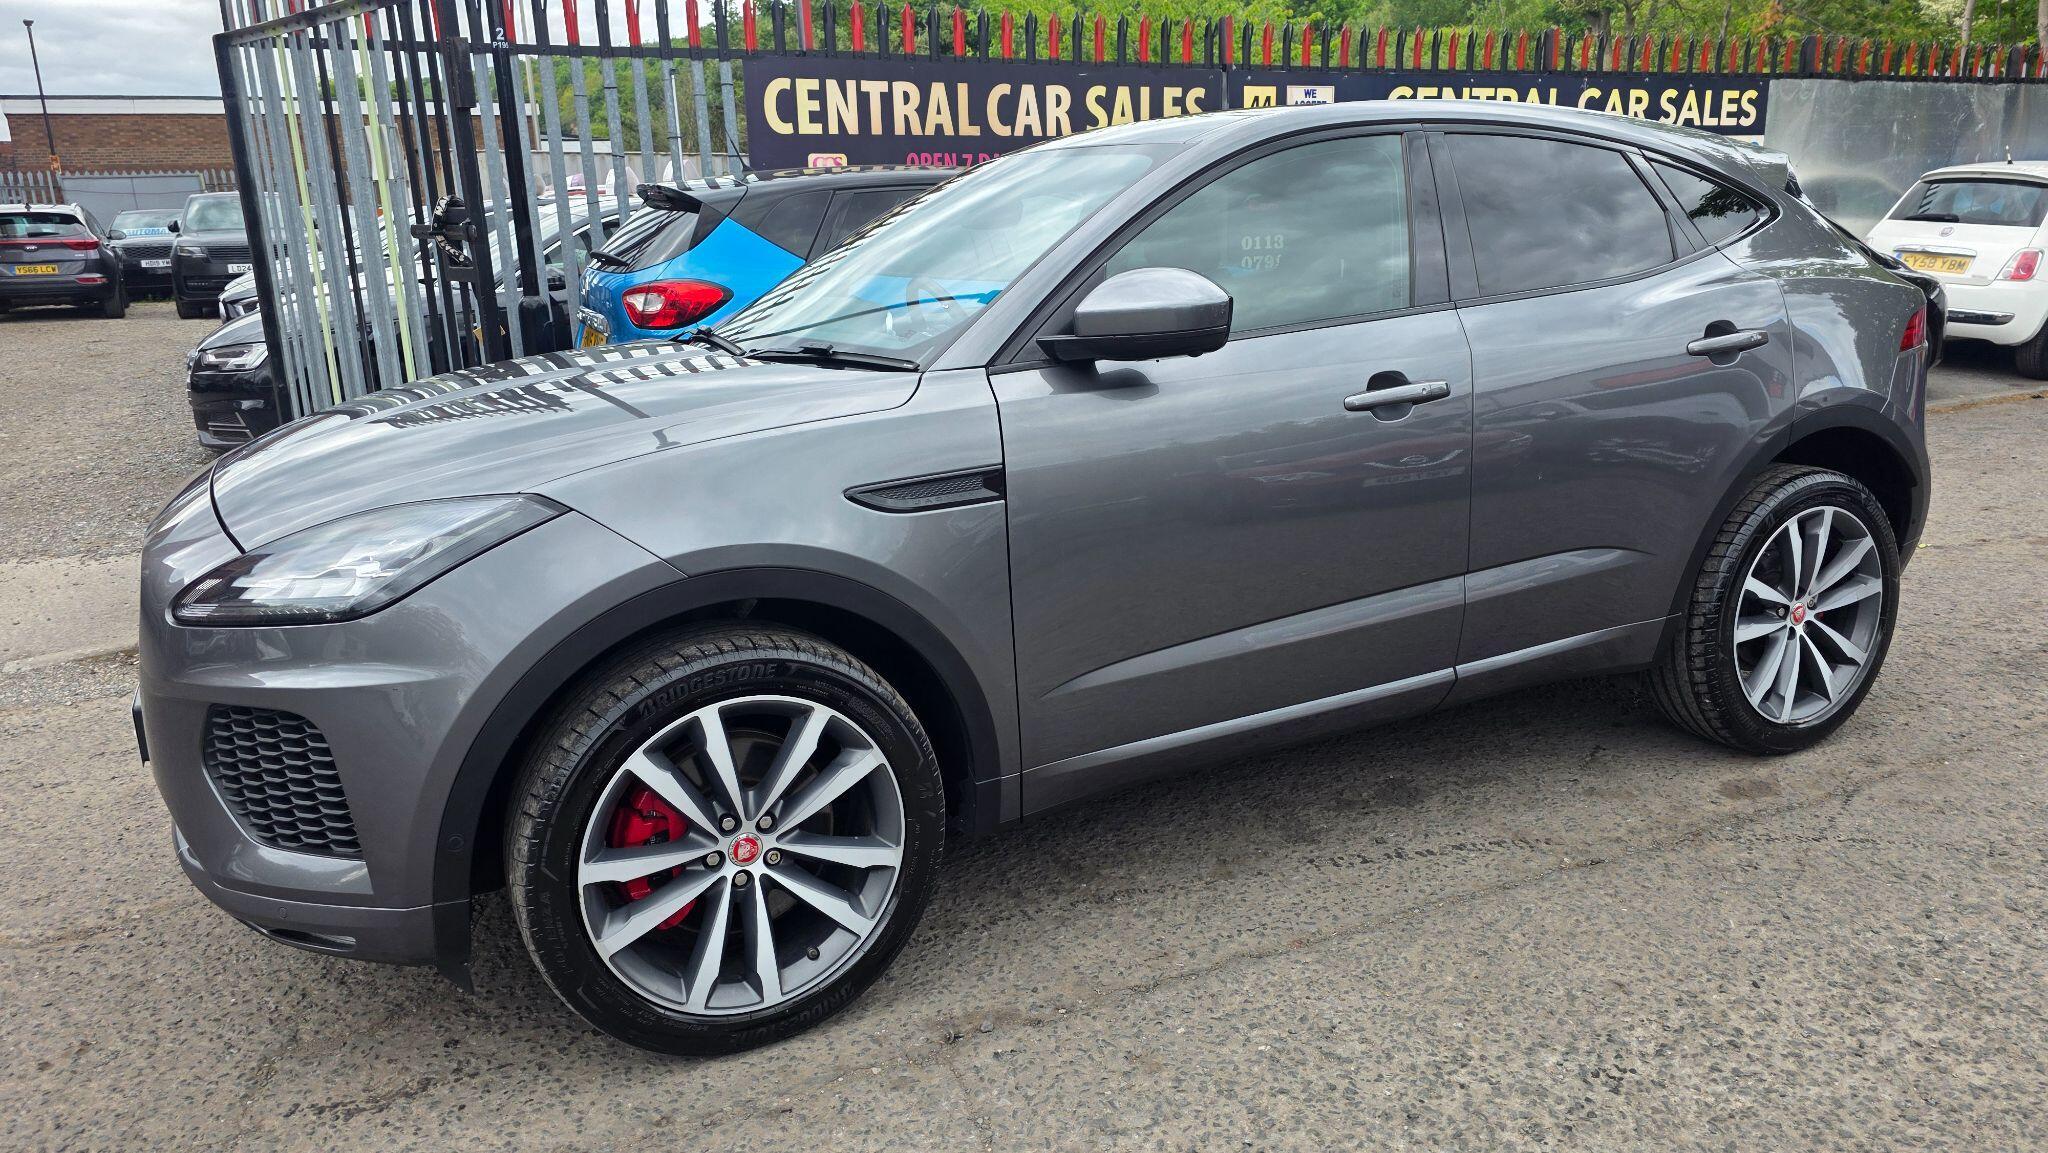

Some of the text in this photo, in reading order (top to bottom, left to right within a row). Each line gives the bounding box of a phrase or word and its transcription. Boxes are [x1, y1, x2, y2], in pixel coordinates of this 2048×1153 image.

[496, 27, 505, 40] 2
[1304, 88, 1317, 98] WE
[763, 77, 1206, 137] CENTRAL CAR SALES
[1658, 88, 1759, 127] SALES
[906, 152, 956, 167] OPEN
[1241, 234, 1284, 250] 0113
[1940, 258, 1967, 271] YBM
